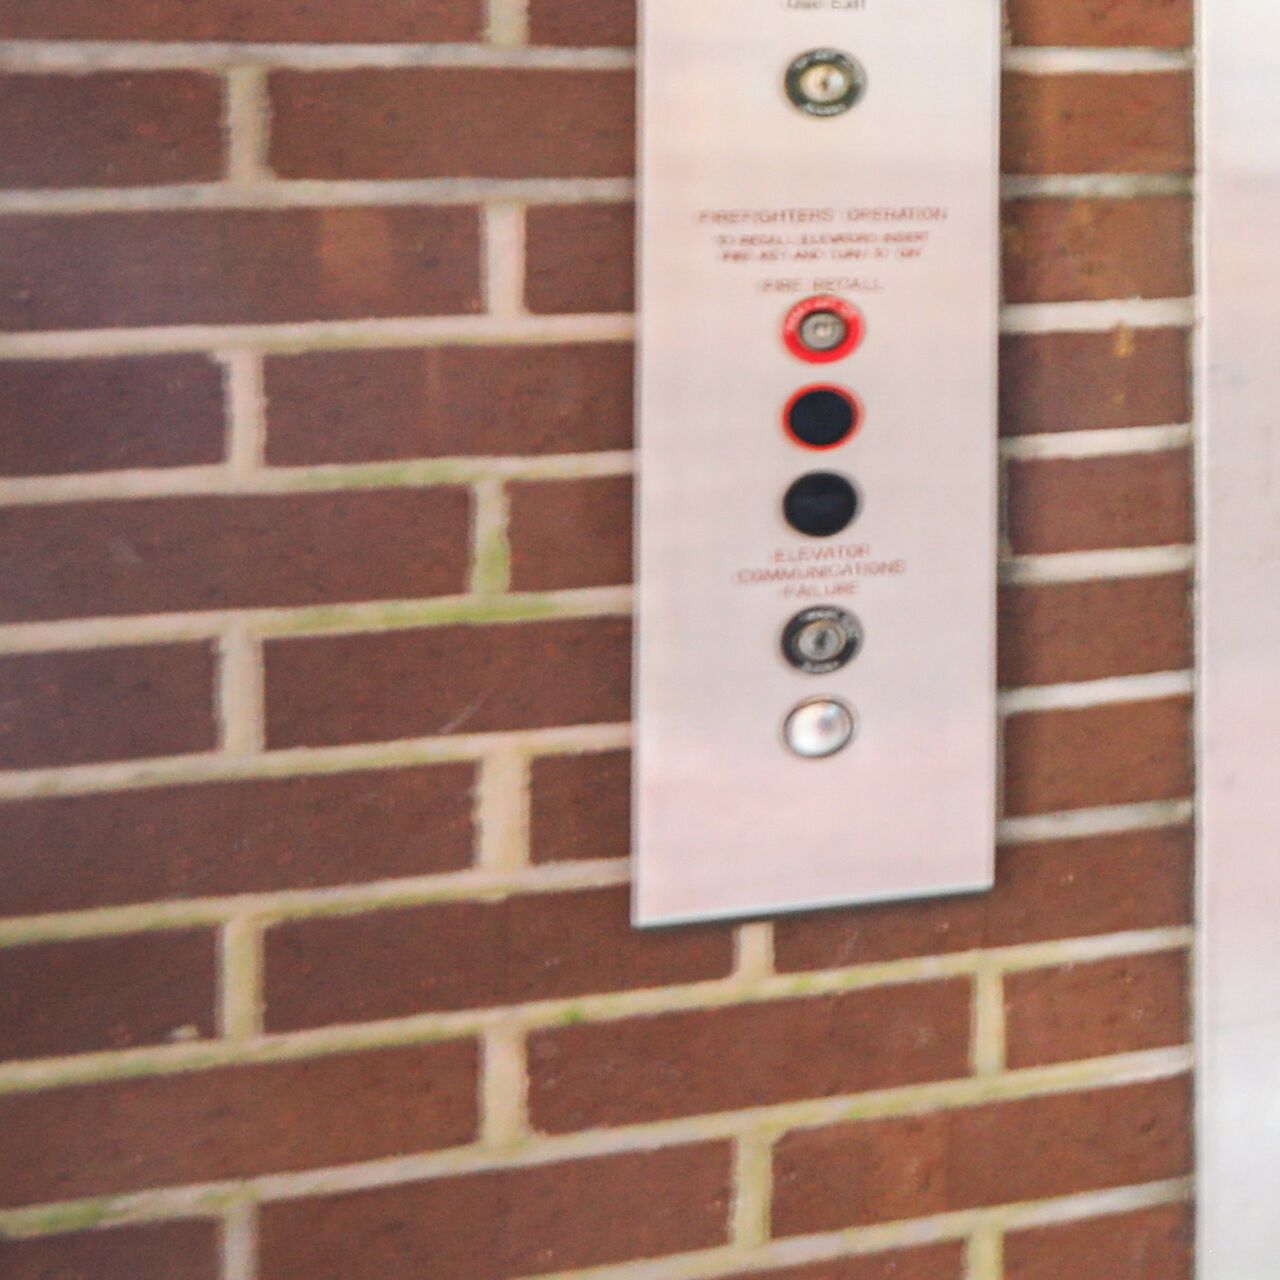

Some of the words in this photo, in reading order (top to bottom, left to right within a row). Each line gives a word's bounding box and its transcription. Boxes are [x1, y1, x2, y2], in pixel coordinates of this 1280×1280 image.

[848, 206, 948, 221] OPERATION
[759, 279, 799, 293] FIRE
[813, 276, 884, 291] RECALL
[774, 545, 870, 563] ELEVATOR
[735, 560, 906, 583] COMMUNICATIONS
